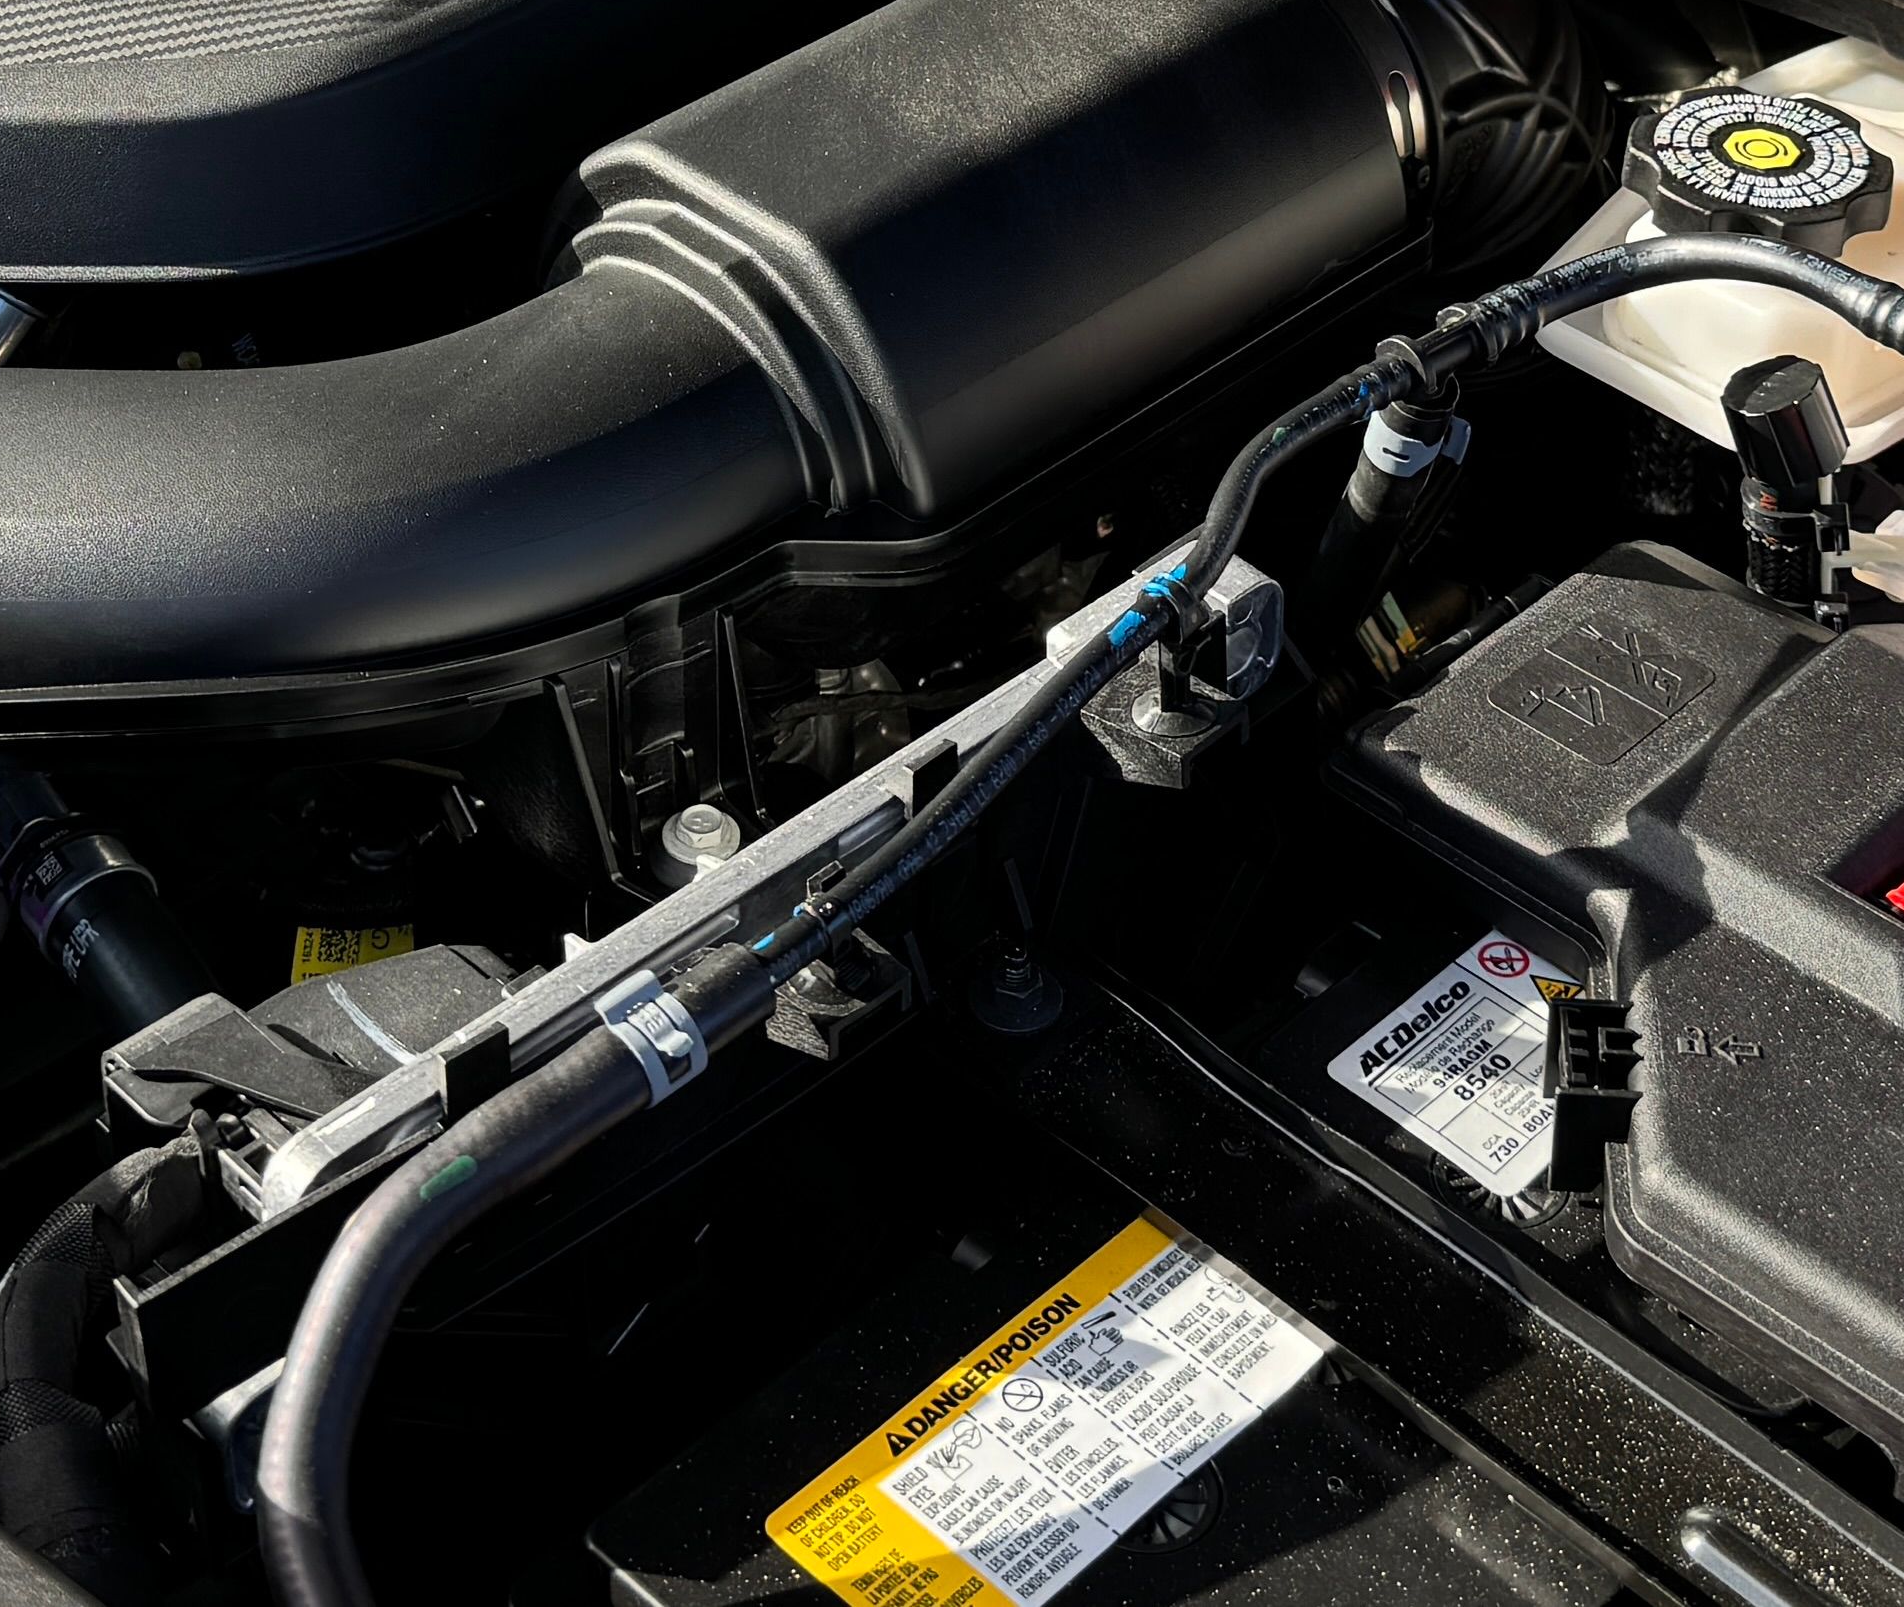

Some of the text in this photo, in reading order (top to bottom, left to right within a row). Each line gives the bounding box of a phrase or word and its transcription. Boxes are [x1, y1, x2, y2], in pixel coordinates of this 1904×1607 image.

[1703, 185, 1746, 204] AVANT
[1360, 981, 1470, 1077] ACDelco
[1450, 1012, 1481, 1039] Model
[1438, 1056, 1452, 1066] de
[1454, 1054, 1511, 1100] 8540
[1489, 1138, 1519, 1162] 730
[1043, 1332, 1085, 1367] SULFURIC
[903, 1293, 1081, 1437] DANGER/POISON
[1059, 1359, 1083, 1379] ACID
[1073, 1357, 1115, 1389] CAN CAUSE
[1041, 1394, 1072, 1420] FLAMES
[995, 1417, 1015, 1433] NO
[1038, 1417, 1074, 1448] SMOKING
[892, 1467, 928, 1496] SHIELD
[1062, 1470, 1081, 1486] LES
[1077, 1483, 1096, 1499] LES
[785, 1475, 860, 1535] KEEP OUT OF REACH
[908, 1486, 936, 1508] EYES
[961, 1496, 980, 1512] CAN
[975, 1475, 1004, 1500] CAUSE
[1010, 1506, 1033, 1525] LES
[1026, 1487, 1055, 1510] YEUX
[1092, 1497, 1109, 1511] DE
[800, 1534, 814, 1548] OF
[813, 1541, 833, 1559] NOT
[844, 1520, 861, 1534] DO
[856, 1507, 876, 1525] NOT
[827, 1523, 883, 1571] OPEN BATTERY
[986, 1556, 1006, 1573] LES
[1000, 1543, 1021, 1561] GAZ
[1001, 1518, 1080, 1586] PEUVENT BLESSER OU
[919, 1568, 939, 1584] PAS
[1016, 1543, 1082, 1599] RENDRE AVEUGLE
[865, 1592, 882, 1605] LA
